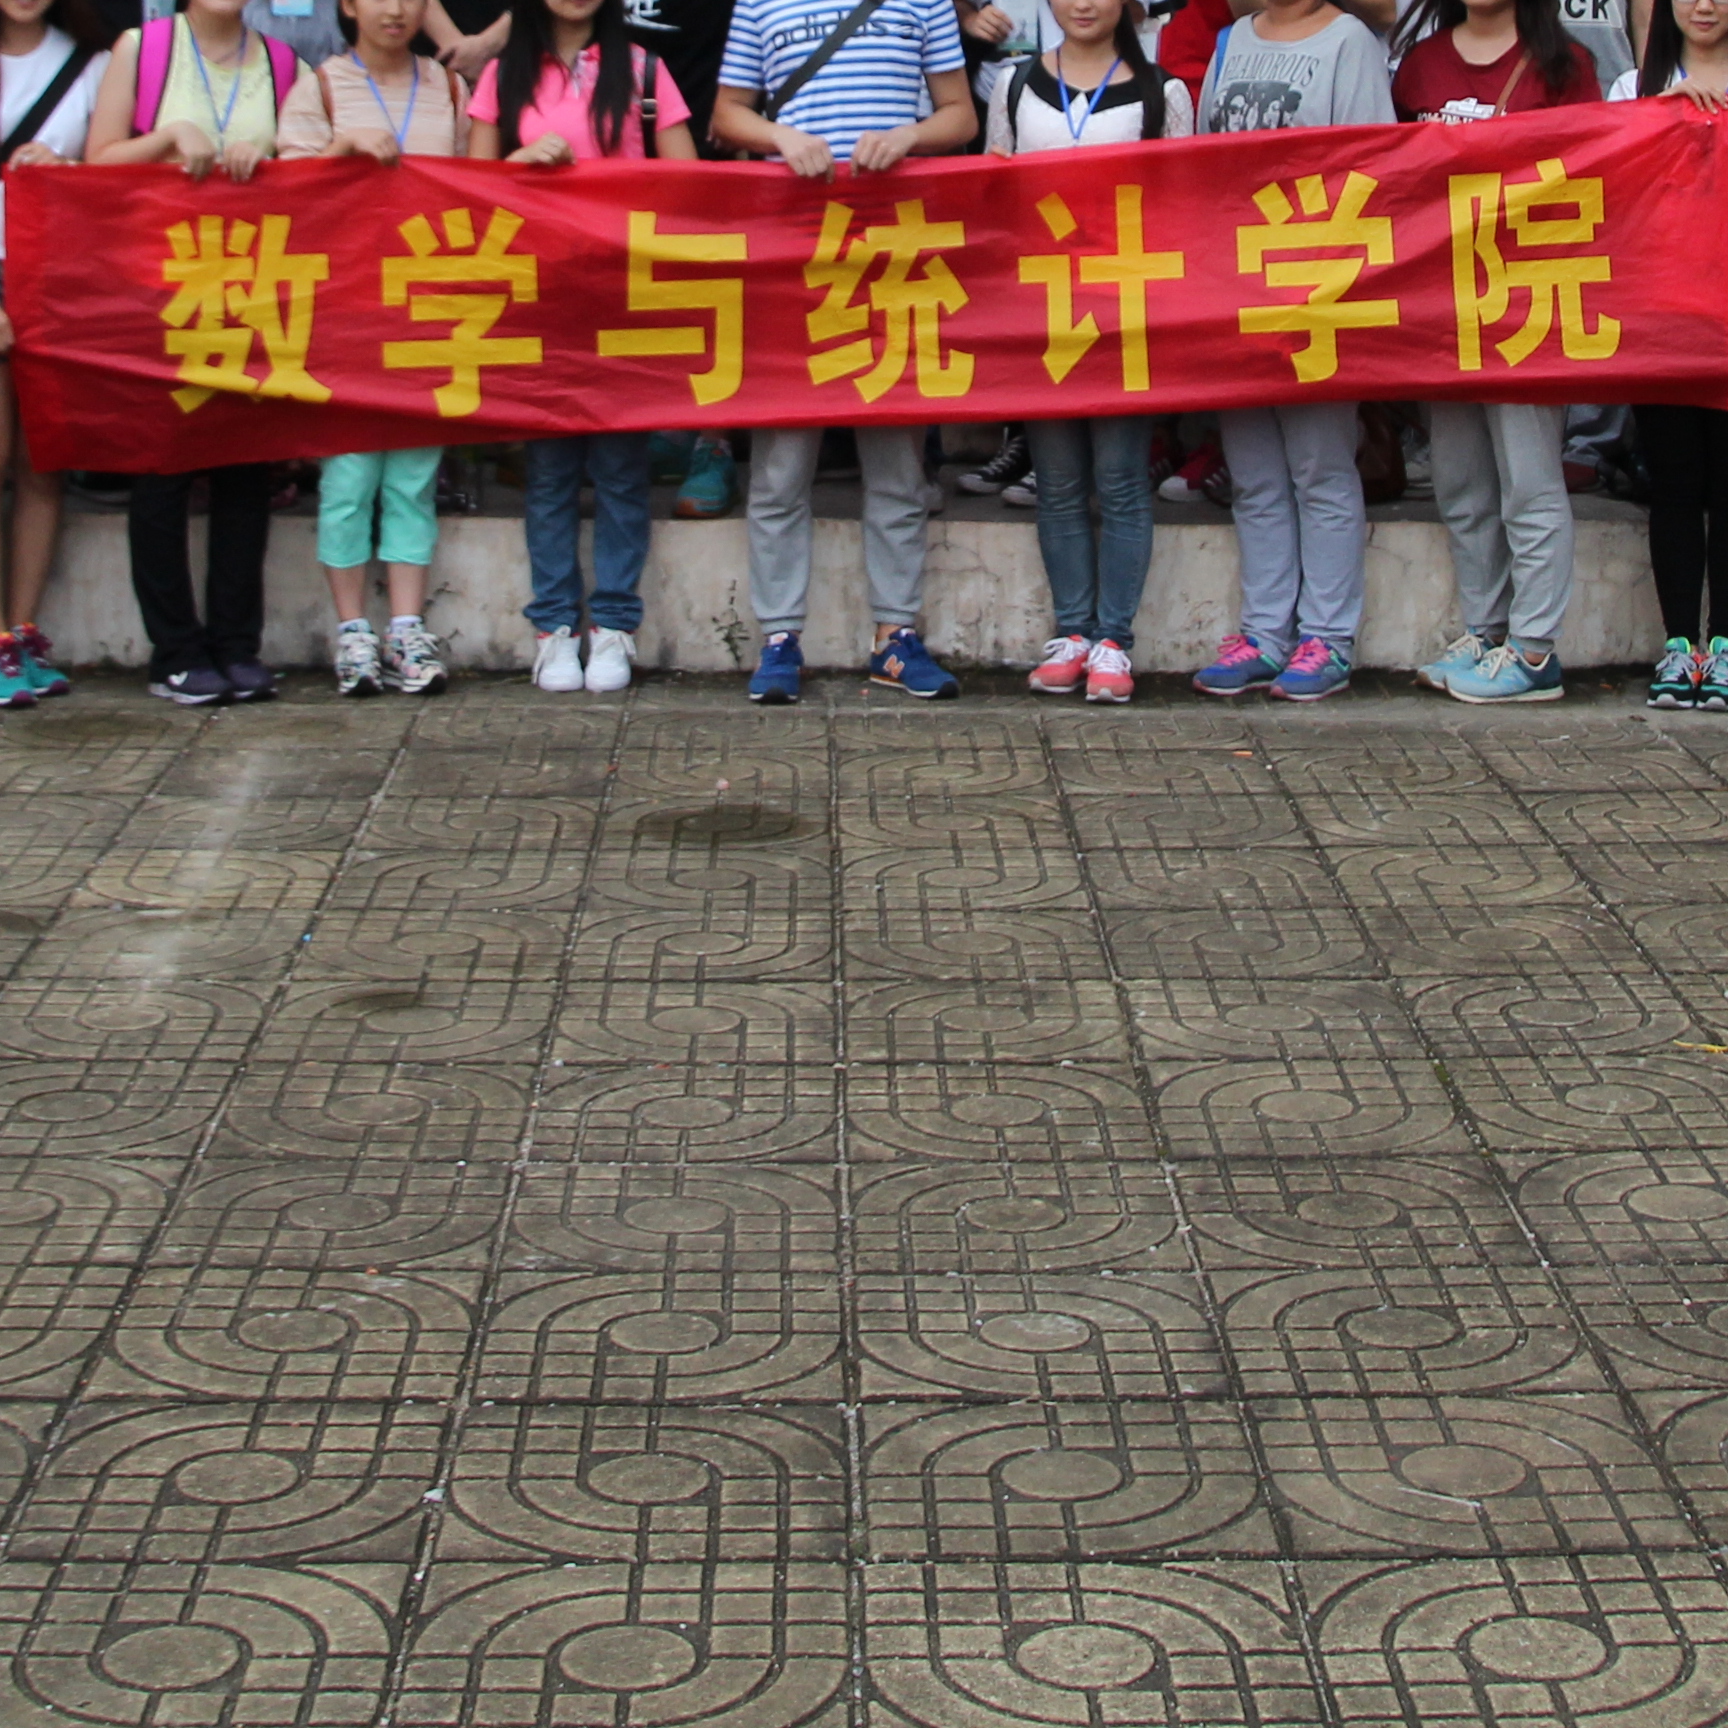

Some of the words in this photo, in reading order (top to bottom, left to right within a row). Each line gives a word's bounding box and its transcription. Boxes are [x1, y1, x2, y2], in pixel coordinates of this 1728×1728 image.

[159, 156, 1624, 418] 数学与统计学院
